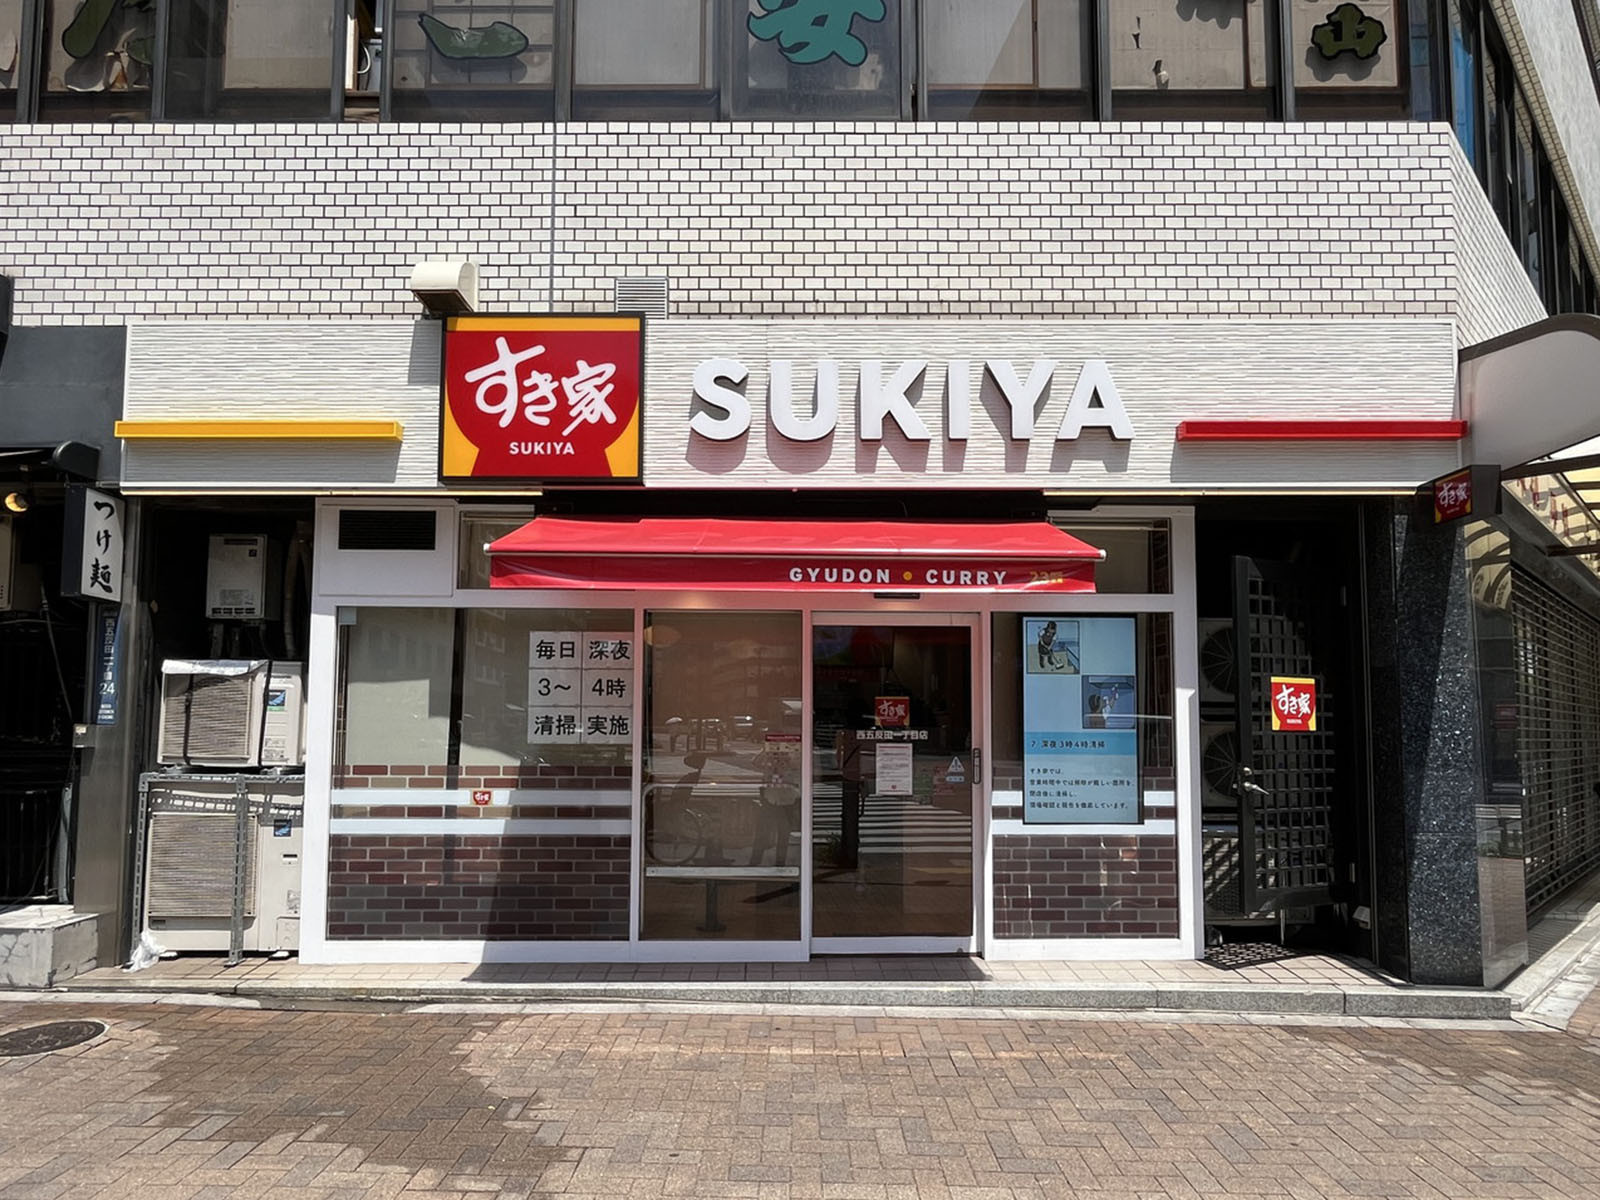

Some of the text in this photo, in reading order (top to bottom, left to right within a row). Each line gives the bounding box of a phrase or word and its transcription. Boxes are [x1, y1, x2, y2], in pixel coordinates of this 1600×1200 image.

[464, 336, 617, 437] すき家
[690, 358, 1136, 440] SUKIYA
[509, 442, 575, 456] SUKIYA
[1438, 482, 1468, 507] すき家
[90, 501, 115, 594] つけ麺
[789, 567, 891, 583] GYUDON
[926, 569, 1007, 585] CURRY
[536, 640, 631, 660] 毎日 深夜
[99, 682, 115, 695] 24
[592, 678, 626, 698] 4時
[1275, 684, 1311, 718] すき家
[534, 715, 630, 736] 清掃 実施
